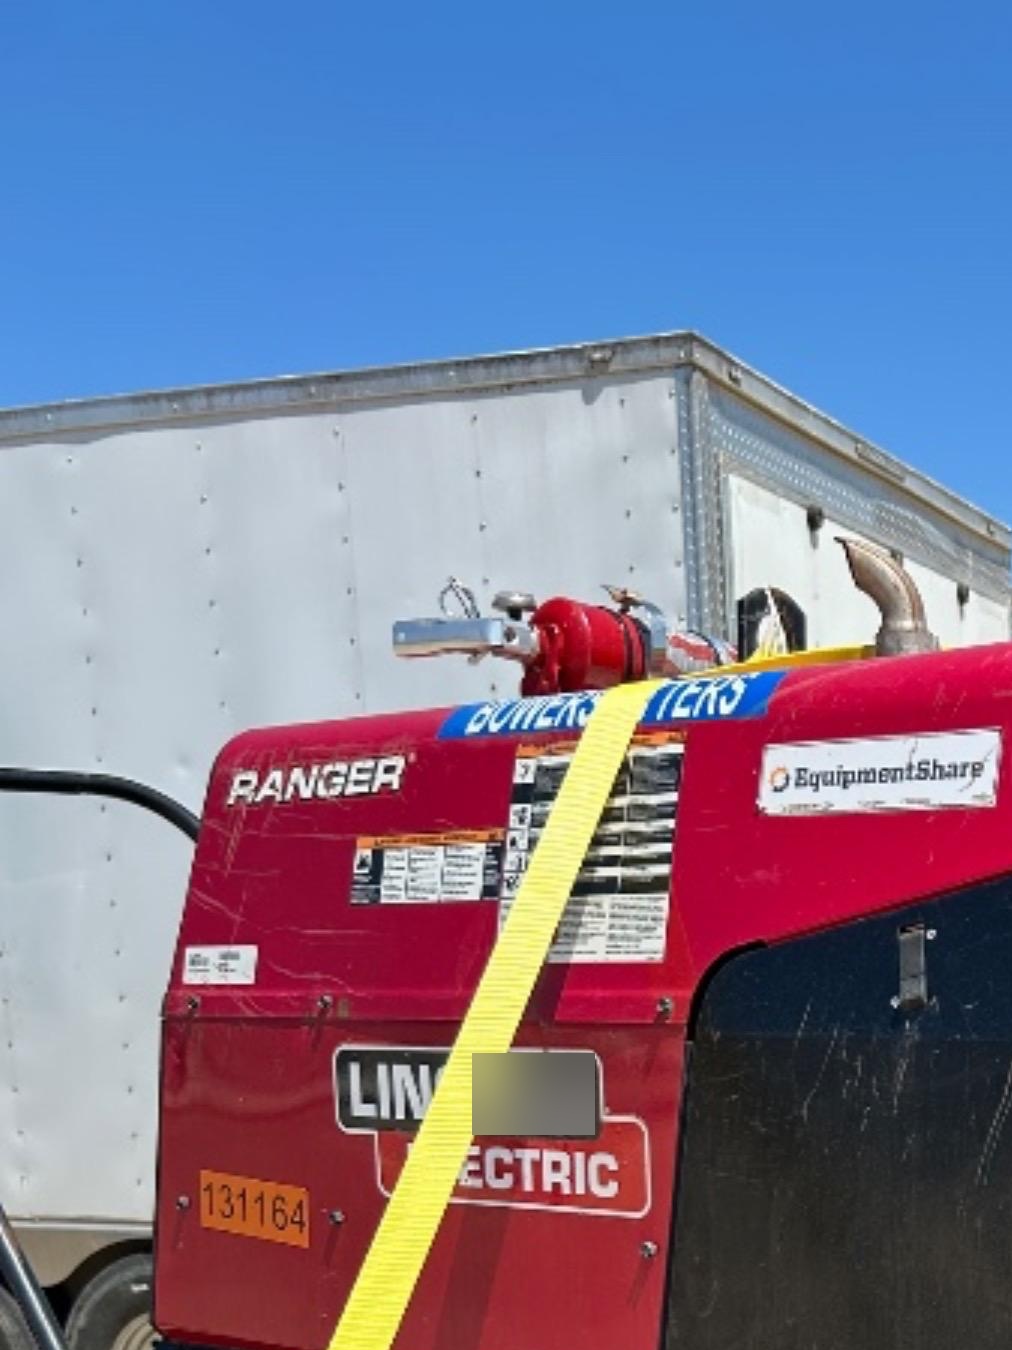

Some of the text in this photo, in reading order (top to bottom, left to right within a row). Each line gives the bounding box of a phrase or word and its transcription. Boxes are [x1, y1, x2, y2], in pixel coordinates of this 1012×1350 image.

[226, 754, 406, 806] RANGER
[793, 758, 985, 793] EquipmentShare
[407, 1142, 620, 1199] ECTRIC
[203, 1181, 306, 1234] 131164
